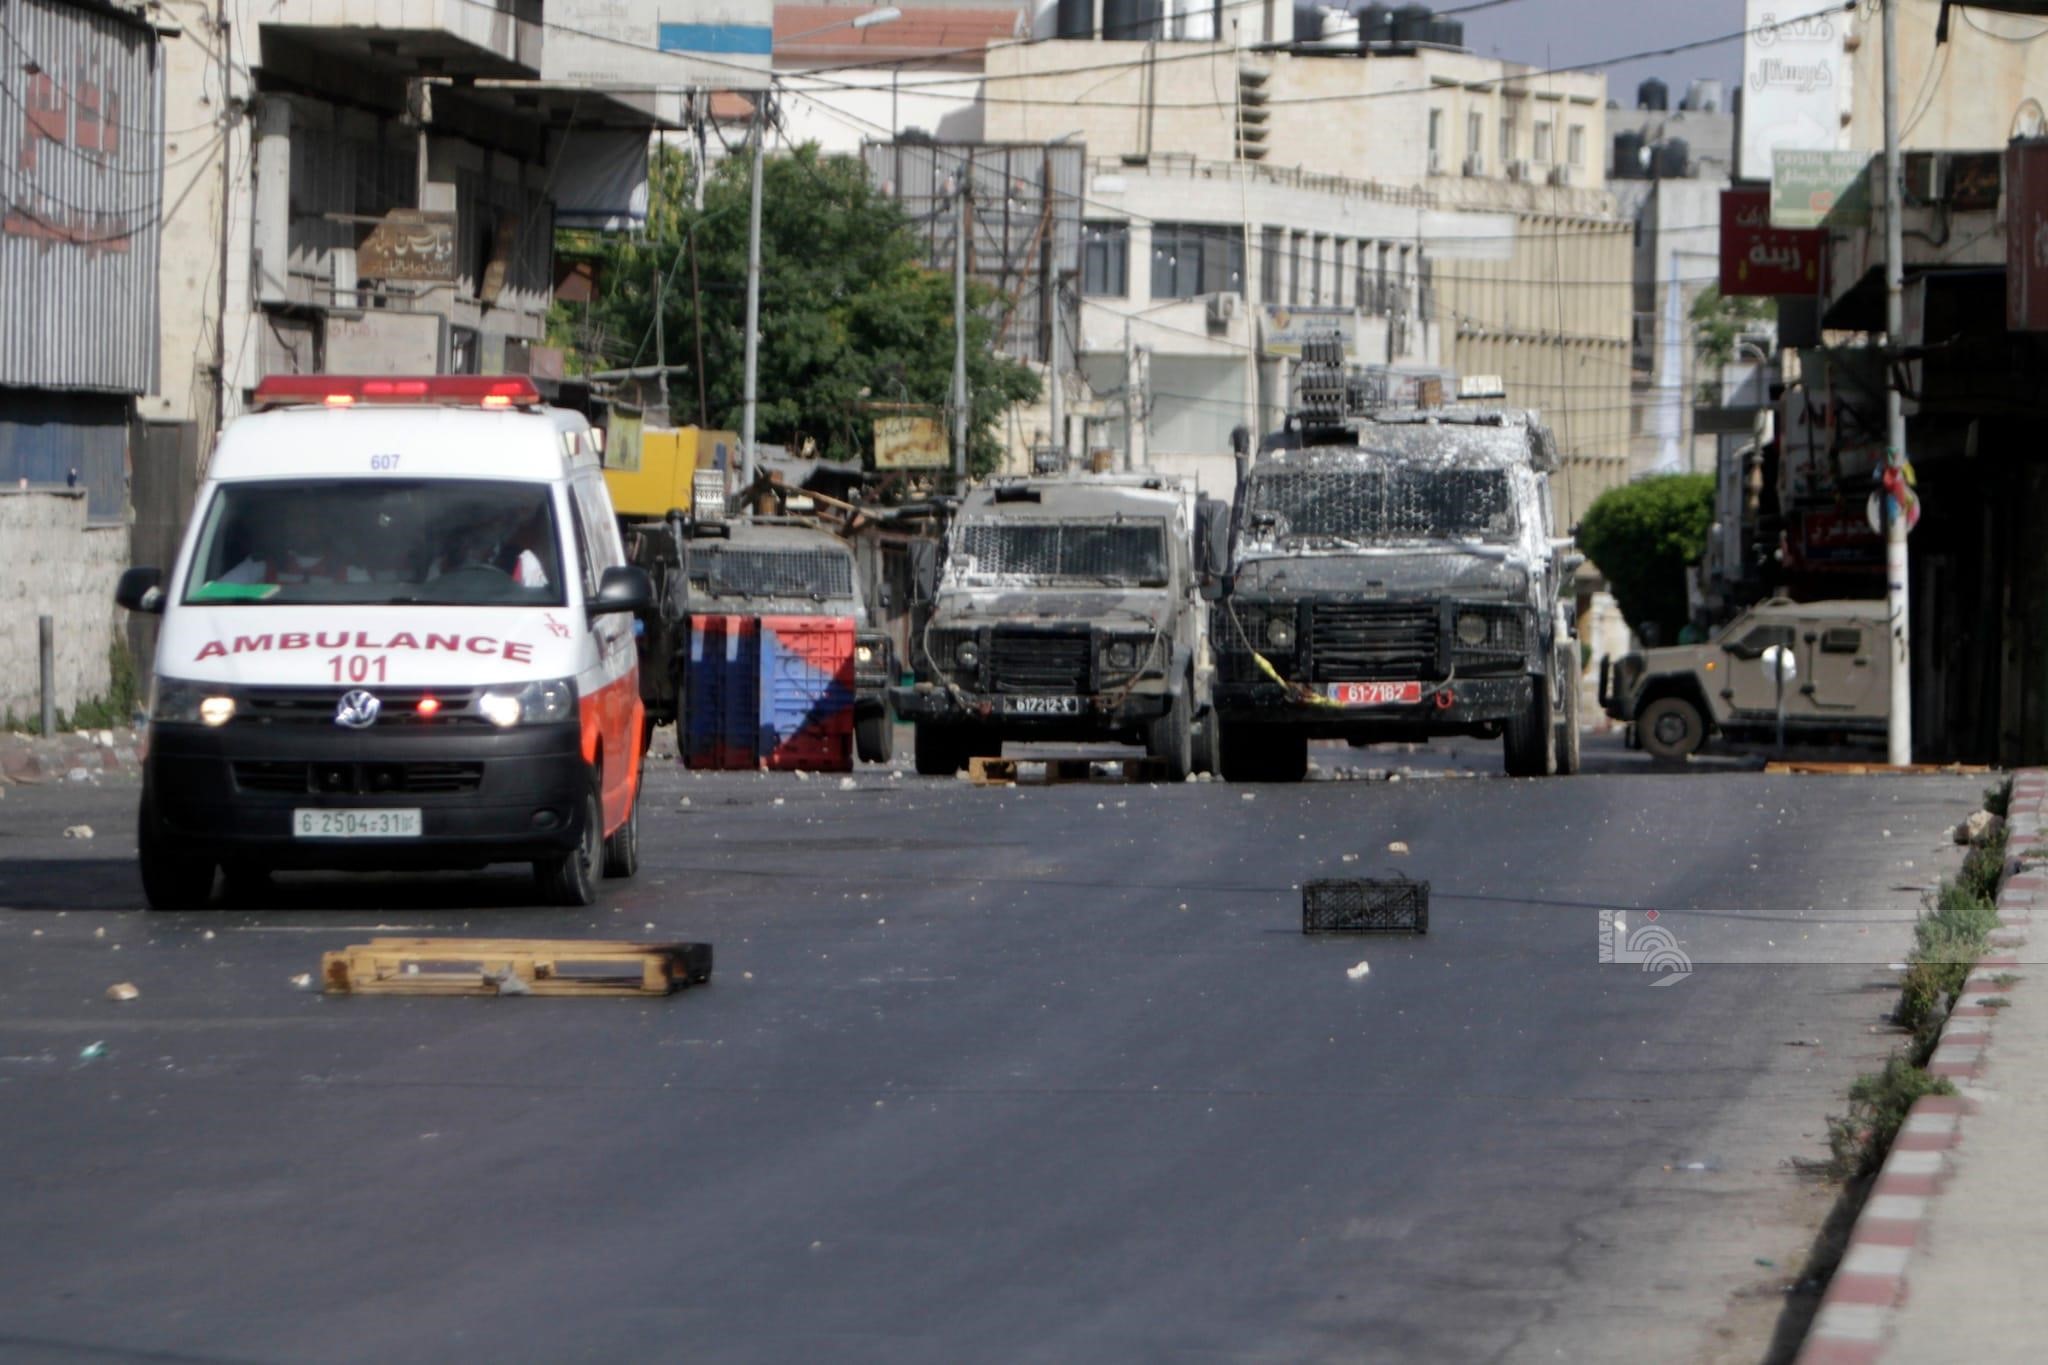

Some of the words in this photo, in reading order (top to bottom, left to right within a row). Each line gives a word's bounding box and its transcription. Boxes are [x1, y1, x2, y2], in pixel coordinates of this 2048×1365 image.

[1752, 11, 1833, 48] فندق
[1750, 58, 1832, 92] كريستال
[1749, 234, 1801, 272] زينة
[371, 454, 400, 470] 607
[194, 631, 534, 664] AMBULANCE
[327, 655, 387, 682] 101
